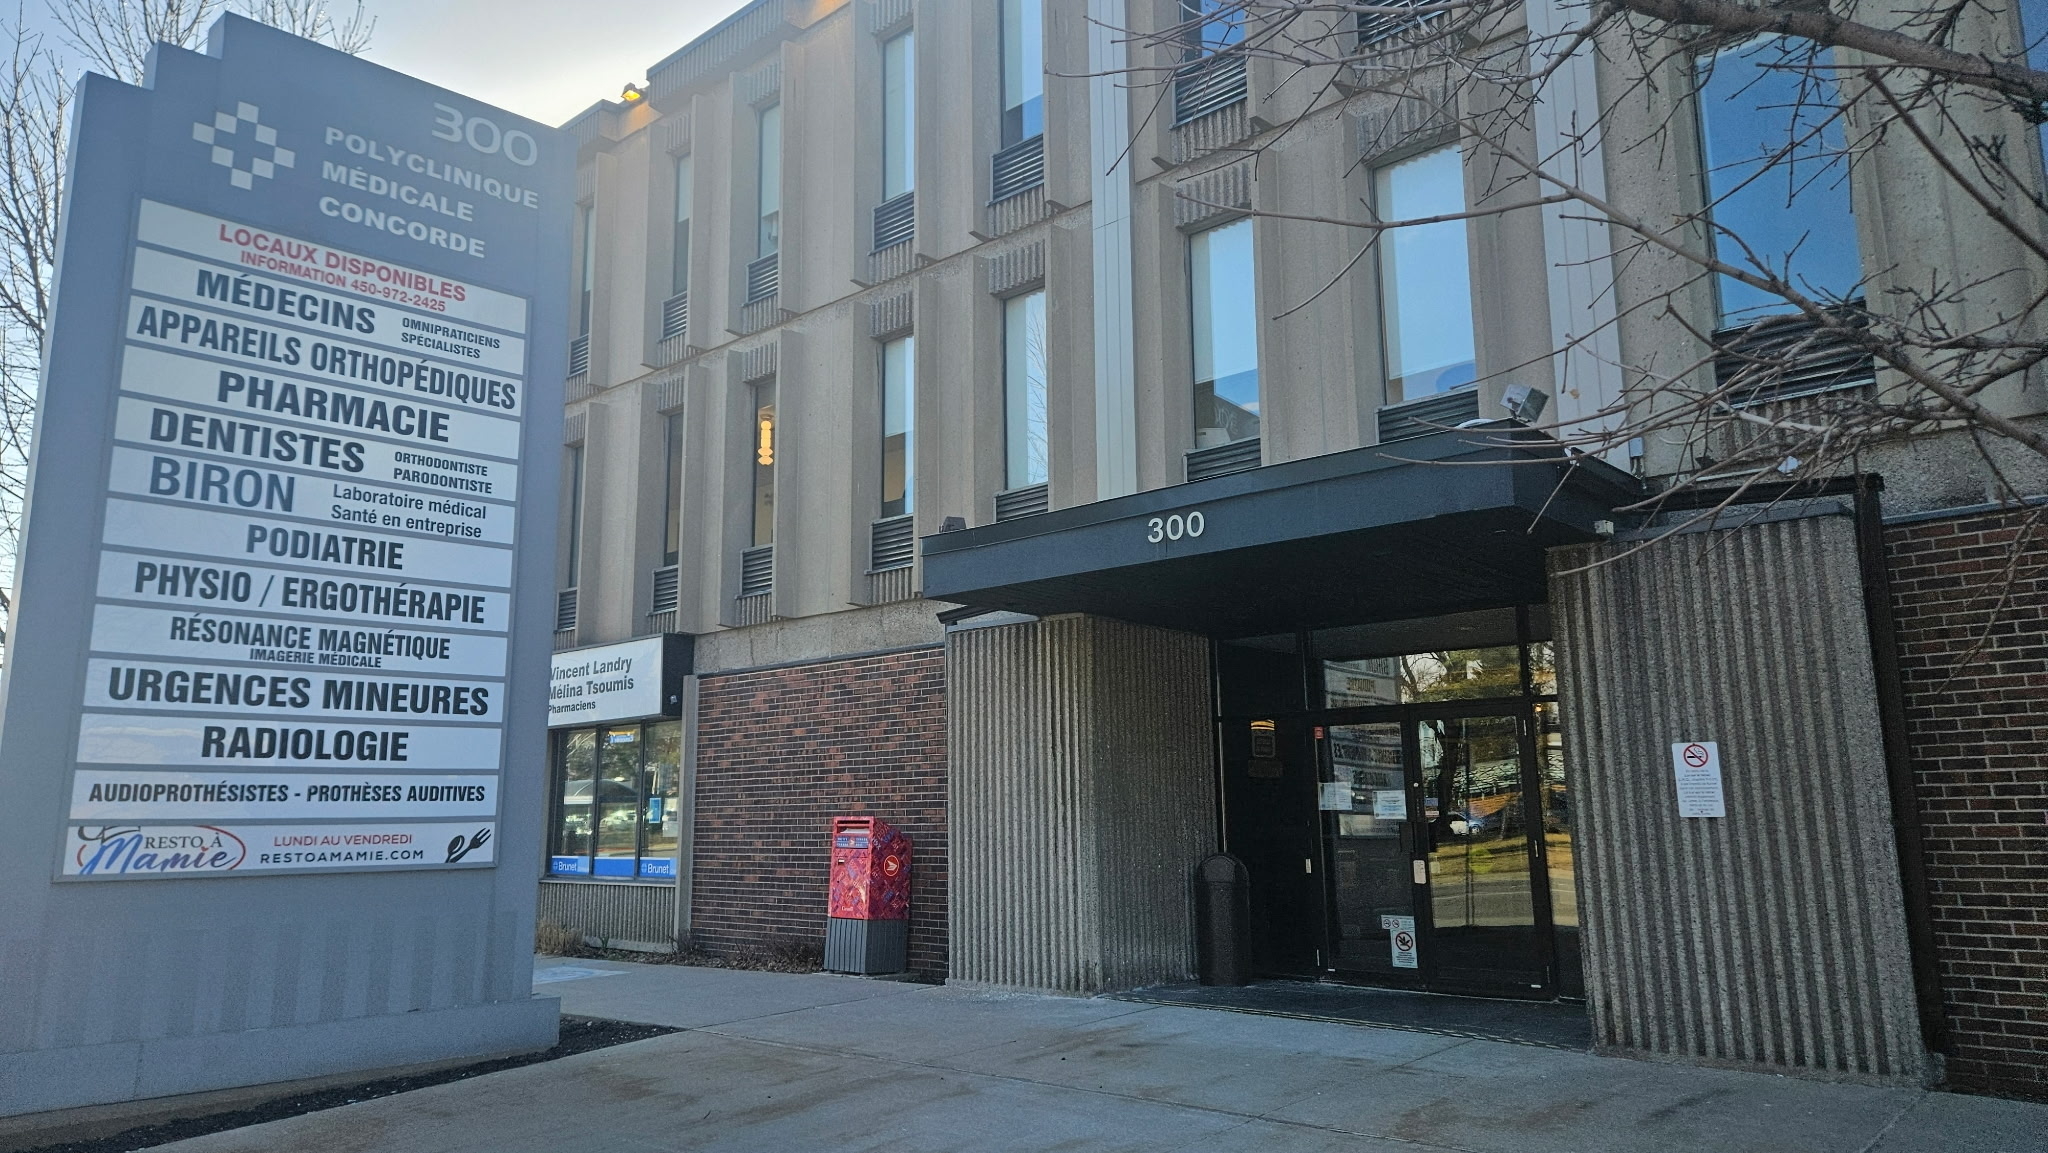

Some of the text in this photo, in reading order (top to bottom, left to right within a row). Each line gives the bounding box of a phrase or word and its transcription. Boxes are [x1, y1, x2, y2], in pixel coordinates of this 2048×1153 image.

[431, 102, 538, 167] 300
[325, 126, 538, 209] POLYCLINIQUE
[321, 160, 474, 221] MÉDICALE
[319, 196, 486, 258] CONCORDE
[219, 223, 466, 301] LOCAUX DISPONIBLES
[197, 264, 376, 334] MÉDECINS
[240, 250, 446, 312] INFORMATION 450-972-2425
[401, 332, 481, 358] SPÉCIALISTES
[402, 317, 500, 349] OMNIPRATICIENS
[136, 306, 516, 409] APPAREILS ORTHOPÉDIQUES
[217, 370, 450, 443] PHARMACIE
[150, 407, 365, 473] DENTISTES
[393, 468, 493, 494] PARODONTISTE
[394, 451, 488, 476] ORTHODONTISTE
[149, 456, 295, 512] BIRON
[333, 484, 487, 519] Laboratoire médical
[331, 504, 482, 538] Santé en entreprise
[1147, 511, 1205, 543] 300
[246, 523, 404, 570] PODIATRIE
[134, 561, 485, 624] PHYSIO / ERGOTHÉRAPIE
[170, 613, 450, 660] RÉSONANCE MAGNÉTIQUE
[250, 648, 382, 668] IMAGERIE MÉDICALE
[593, 657, 632, 674] Landry
[108, 666, 489, 716] URGENCES MINEURES
[586, 675, 634, 695] Tsoumis
[200, 725, 409, 762] RADIOLOGIE
[88, 780, 289, 803] AUDIOPROTHÉSISTES
[306, 781, 402, 803] PROTHÈSES
[406, 785, 485, 803] AUDITIVES
[79, 834, 236, 876] Mamie
[144, 832, 223, 849] RESTO À
[260, 850, 424, 864] RESTOAMAMIE.COM
[274, 834, 412, 847] LUNDI AU VENDREDI
[558, 861, 577, 872] Brunet
[647, 863, 670, 874] Brunet
